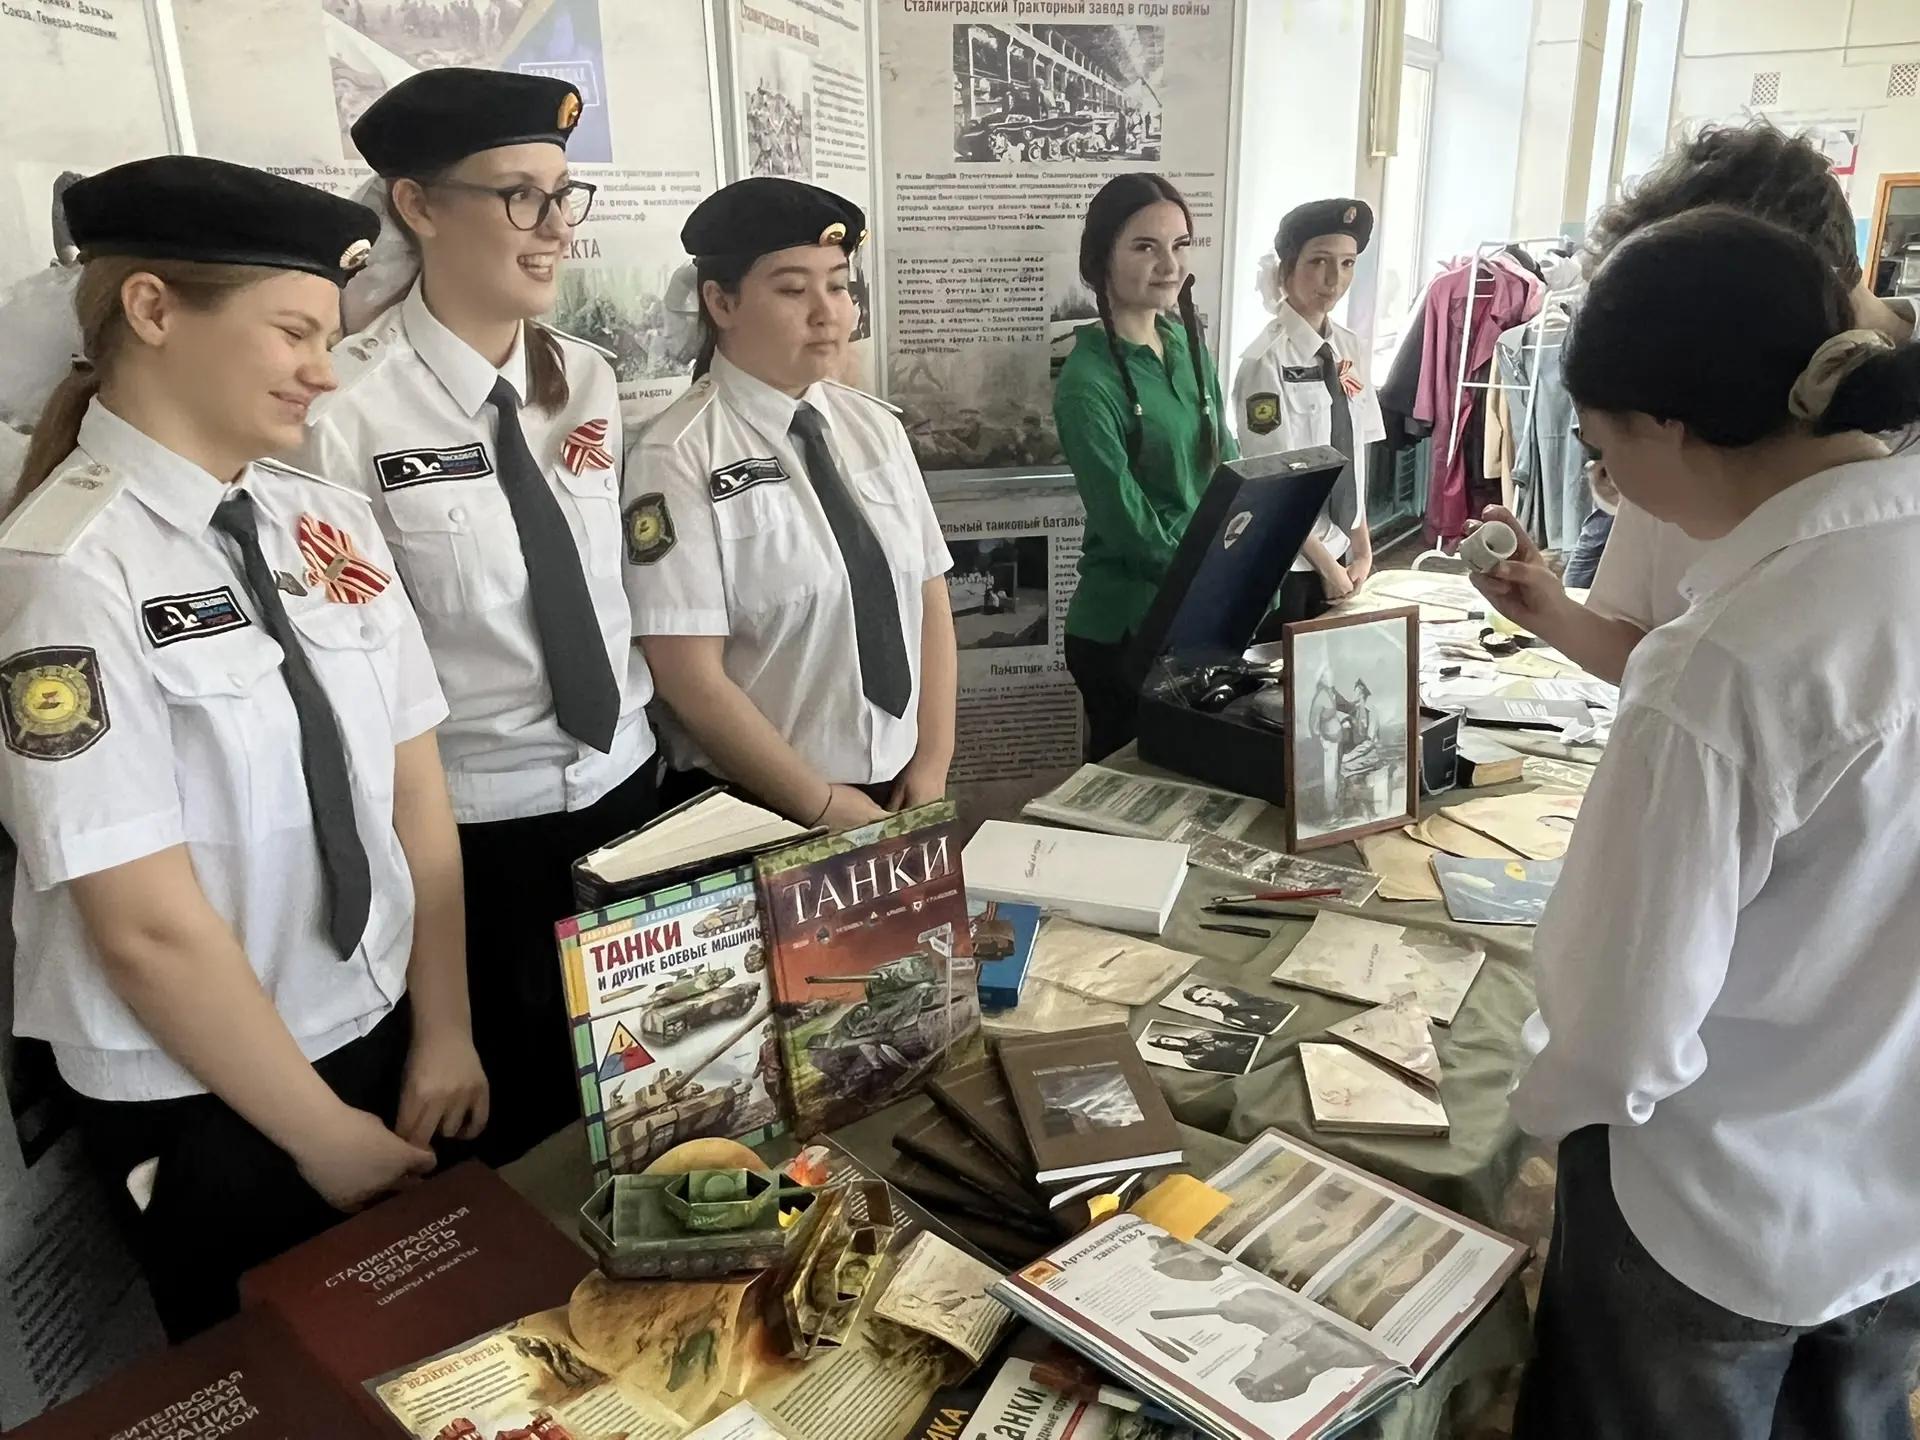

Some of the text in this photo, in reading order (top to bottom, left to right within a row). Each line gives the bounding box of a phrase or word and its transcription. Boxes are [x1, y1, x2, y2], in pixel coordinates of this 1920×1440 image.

[904, 0, 1210, 16] Сталинградский Тракторный завод в годы войны
[563, 239, 601, 259] КТА
[986, 517, 1040, 531] танковый
[783, 835, 954, 925] ТАНКИ
[589, 920, 682, 974] ТАНКИ
[597, 976, 607, 991] И
[611, 960, 656, 990] ДРУГИЕ
[660, 942, 708, 971] БОЕВЫЕ
[325, 1206, 470, 1288] СТАЛИНГРАДСКАЯ
[358, 1228, 457, 1283] ОБЛАСТЬ
[1093, 1228, 1146, 1261] танк КВ-2
[377, 1246, 480, 1306] ЦИФРЫ И ФАКТЫ
